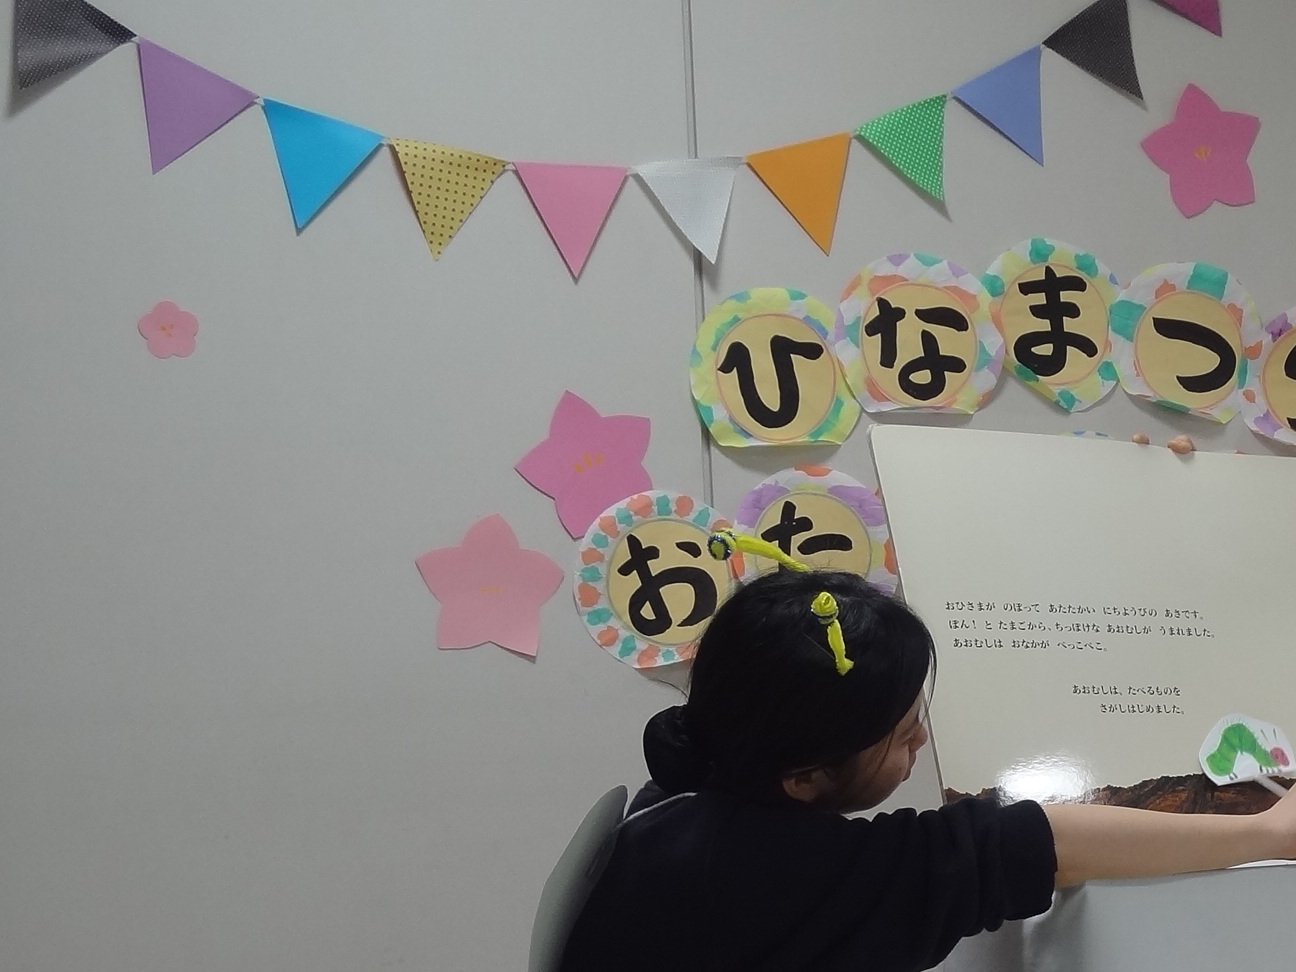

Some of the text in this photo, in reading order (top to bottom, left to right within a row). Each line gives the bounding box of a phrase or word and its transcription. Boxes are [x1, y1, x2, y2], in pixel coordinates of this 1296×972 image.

[945, 601, 1204, 620] おひさまが のぼって あたたかい にちようびの あさです。
[985, 620, 993, 630] と
[1106, 623, 1152, 635] あおむしが
[1159, 626, 1215, 638] うまれました。
[953, 638, 1003, 649] あおむしは
[1011, 639, 1050, 650] おなかが
[1100, 703, 1185, 715] さがしはじめました。
